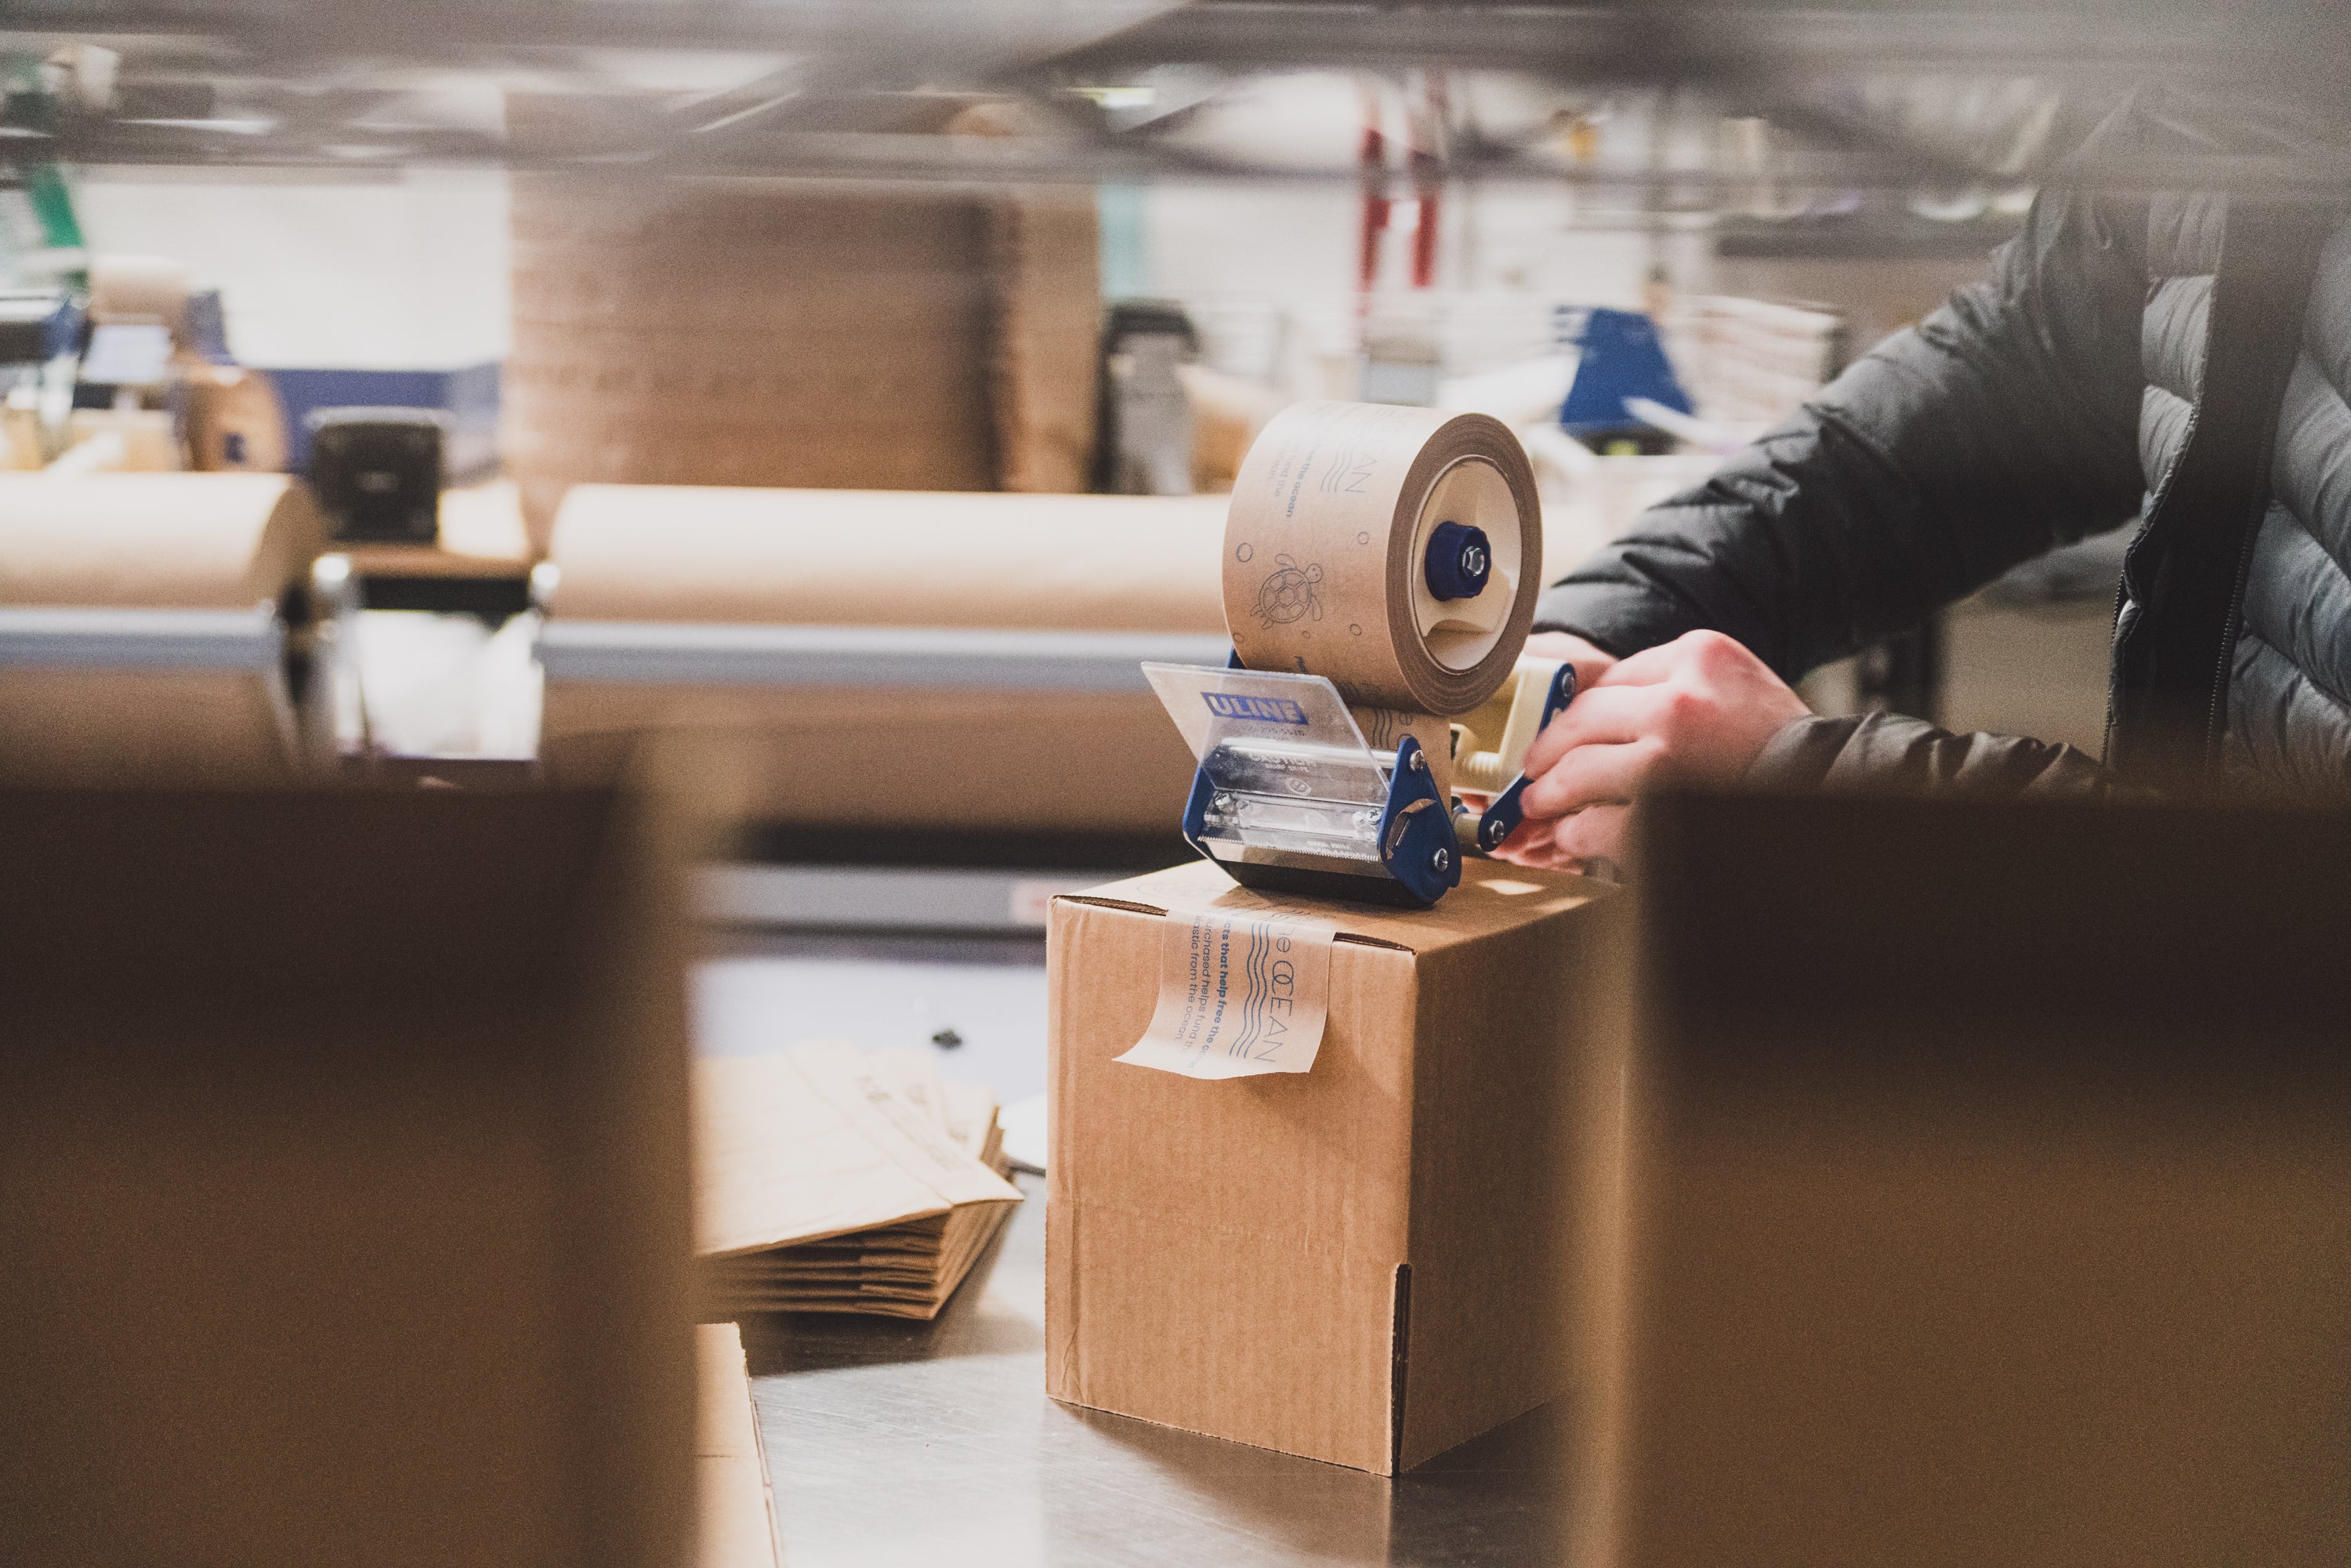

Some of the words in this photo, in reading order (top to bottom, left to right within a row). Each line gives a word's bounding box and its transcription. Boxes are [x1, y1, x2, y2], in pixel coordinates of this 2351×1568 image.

[1286, 481, 1302, 518] ocean
[1208, 694, 1302, 722] ULINE
[1189, 951, 1200, 980] from
[1219, 942, 1230, 969] that
[1188, 981, 1199, 1004] the
[1197, 979, 1212, 1012] helps
[1216, 969, 1230, 998] help
[1214, 998, 1228, 1023] free
[1254, 960, 1295, 1063] OCEAN
[1189, 1014, 1205, 1040] fund
[1207, 1025, 1220, 1044] the
